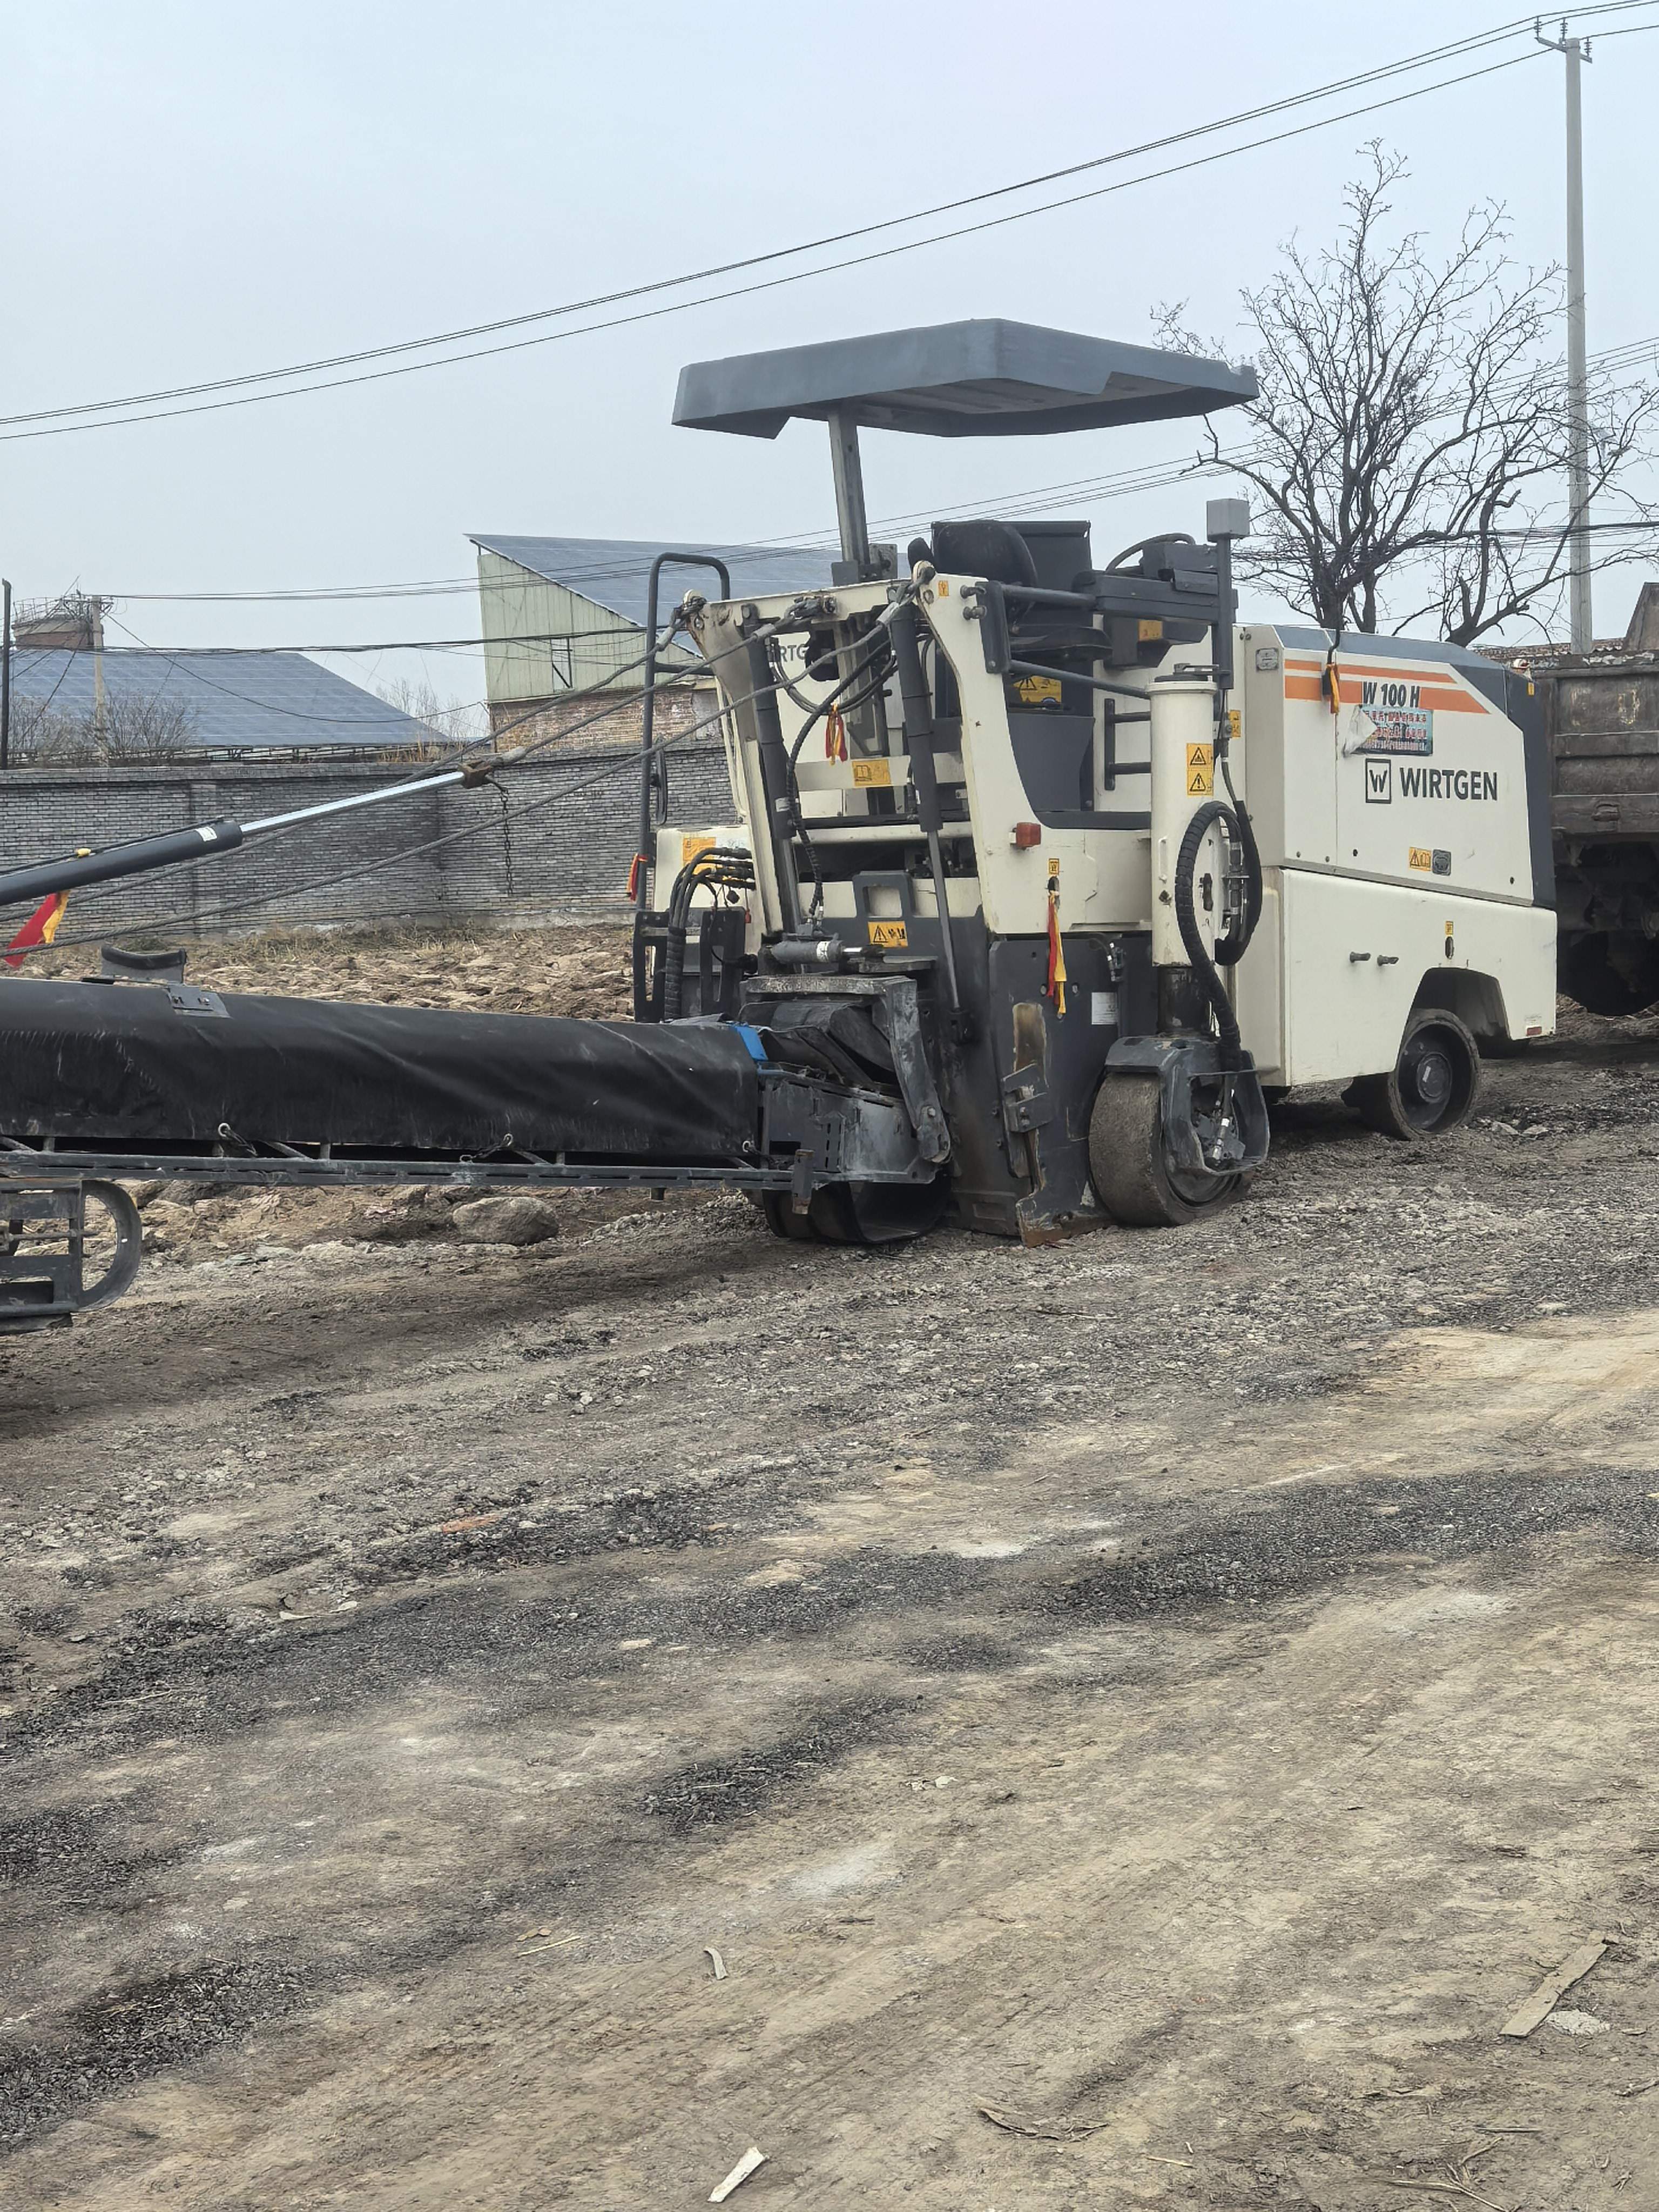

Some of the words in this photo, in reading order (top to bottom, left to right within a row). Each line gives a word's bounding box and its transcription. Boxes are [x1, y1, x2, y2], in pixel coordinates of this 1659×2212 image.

[1363, 682, 1377, 704] W
[1381, 683, 1407, 706] 100
[1410, 685, 1420, 707] H
[1399, 767, 1498, 801] WIRTGEN
